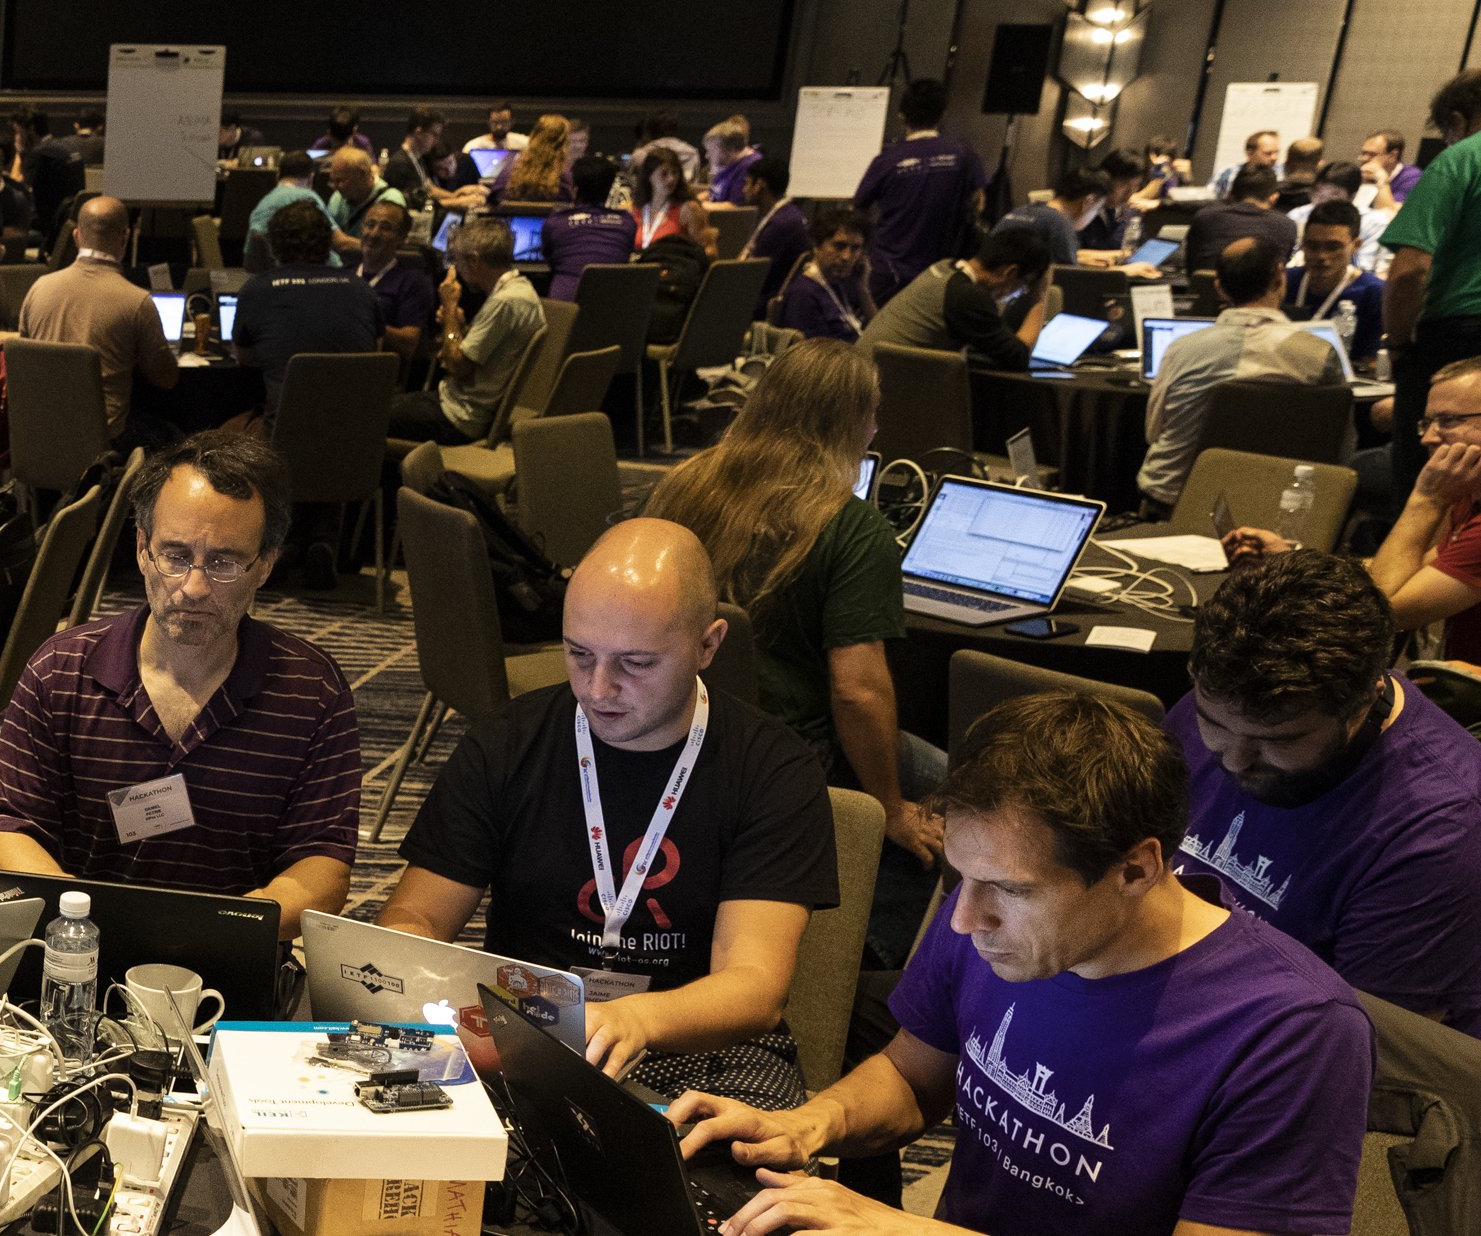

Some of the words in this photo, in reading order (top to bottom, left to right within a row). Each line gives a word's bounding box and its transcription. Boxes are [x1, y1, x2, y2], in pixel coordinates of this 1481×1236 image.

[671, 766, 688, 796] HUAWEI
[128, 785, 173, 802] HACKATHON
[126, 830, 137, 838] 103
[594, 841, 605, 871] HUAWEI
[622, 898, 633, 916] CISCO
[643, 932, 686, 952] RIOT!
[588, 977, 636, 988] HACKATHON
[588, 990, 611, 999] JAIME
[280, 1098, 355, 1108] Development
[956, 1060, 1103, 1184] HACKATHON
[978, 1128, 998, 1153] 103
